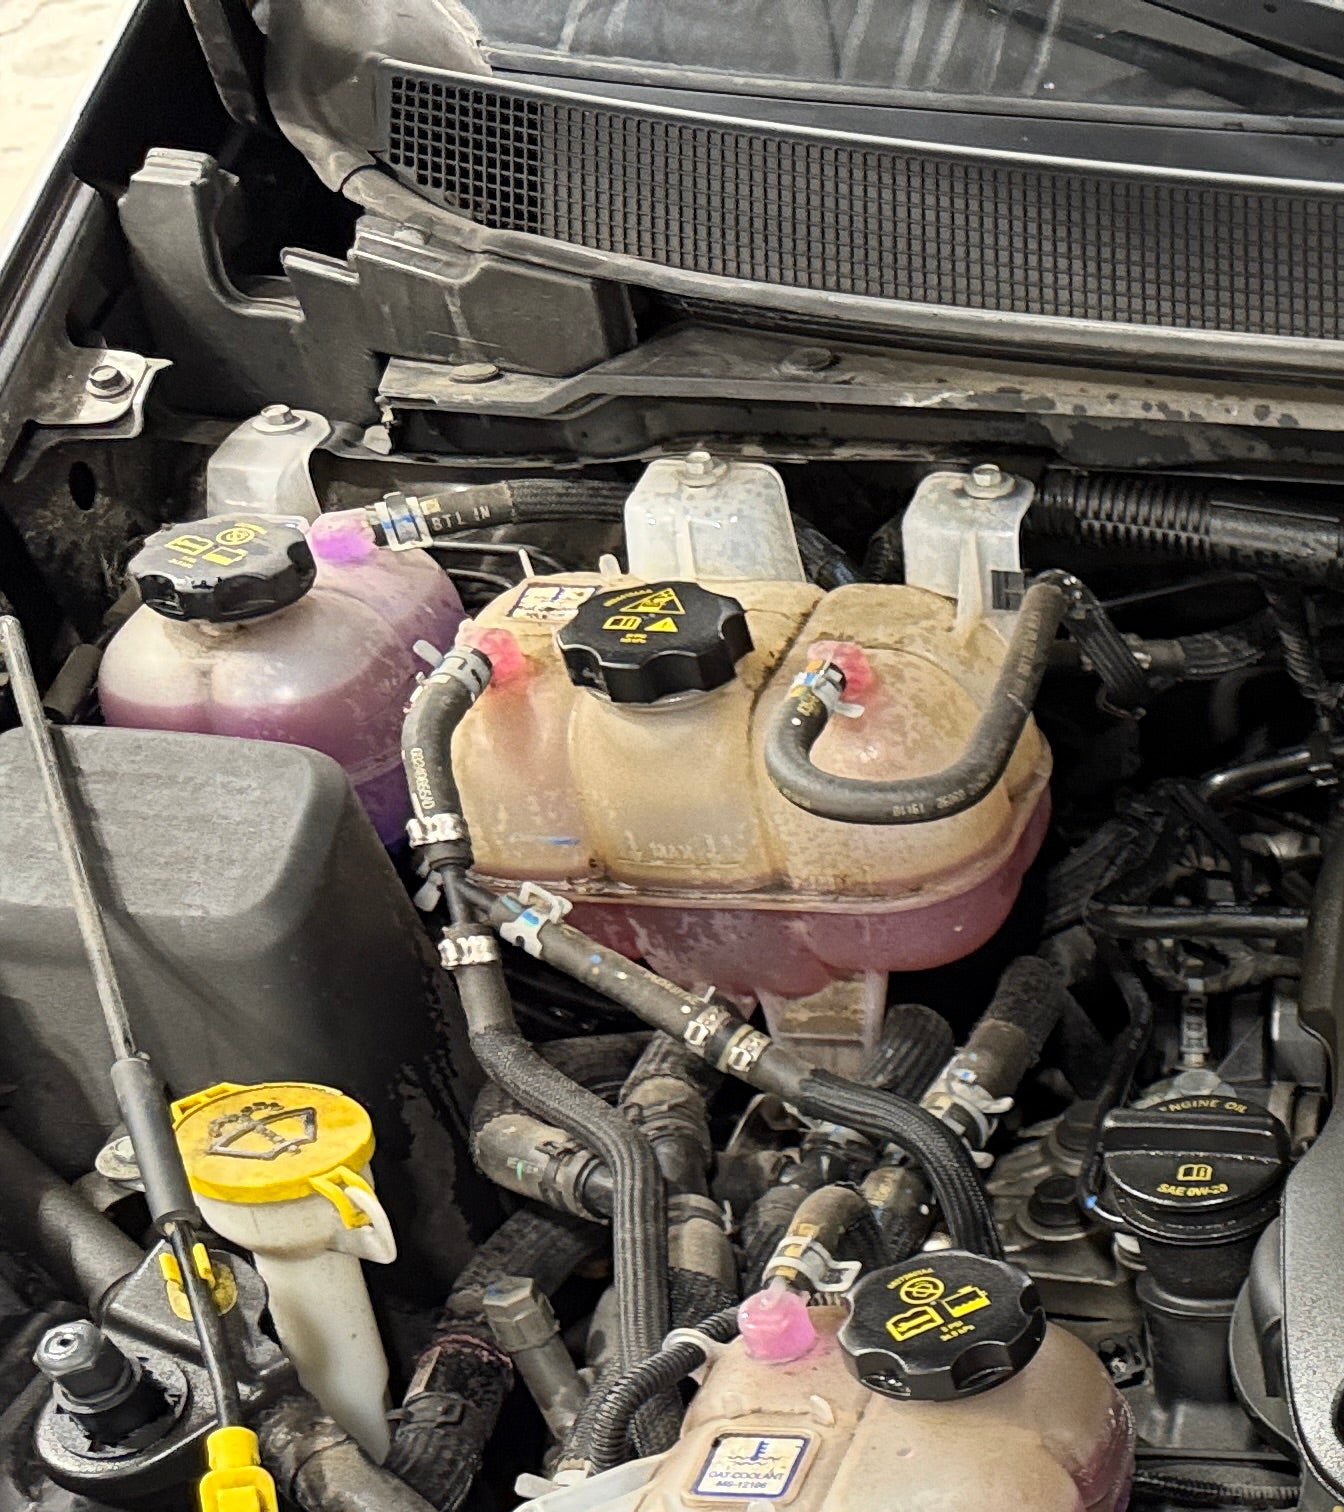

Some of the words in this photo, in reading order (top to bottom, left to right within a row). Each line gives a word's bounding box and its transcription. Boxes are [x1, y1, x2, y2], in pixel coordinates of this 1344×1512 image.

[472, 504, 491, 522] IN
[1223, 1101, 1248, 1114] OIL
[1156, 1183, 1185, 1197] SAE
